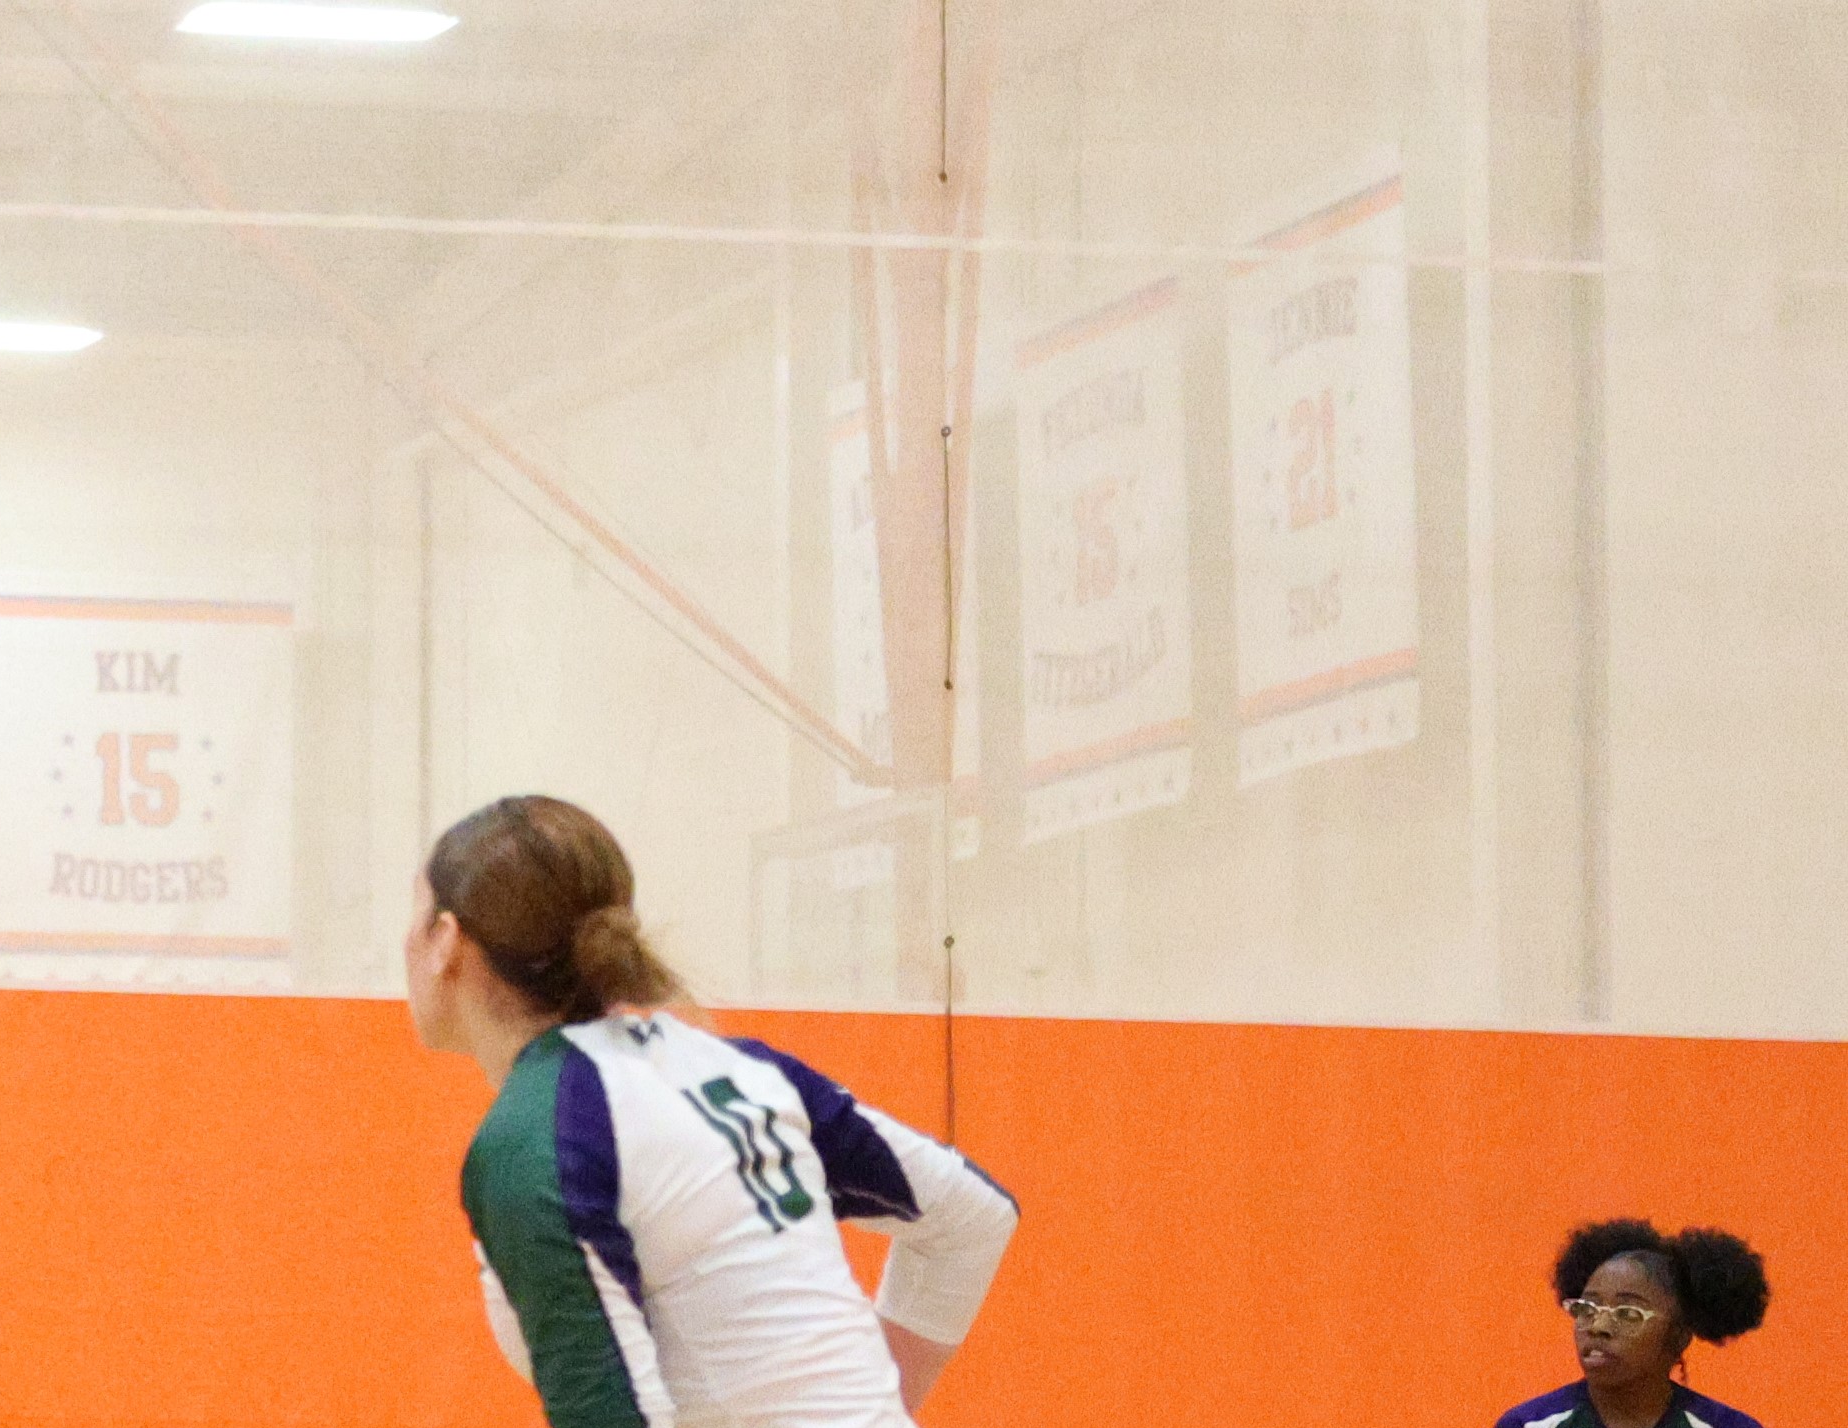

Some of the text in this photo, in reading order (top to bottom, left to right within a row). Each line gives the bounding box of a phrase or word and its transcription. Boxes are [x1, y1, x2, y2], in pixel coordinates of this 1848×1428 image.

[1287, 385, 1339, 531] 21
[1074, 474, 1121, 606] 15
[93, 650, 183, 696] KIM
[94, 731, 182, 828] 15
[48, 851, 231, 904] RODGERS
[681, 1076, 815, 1234] 10
